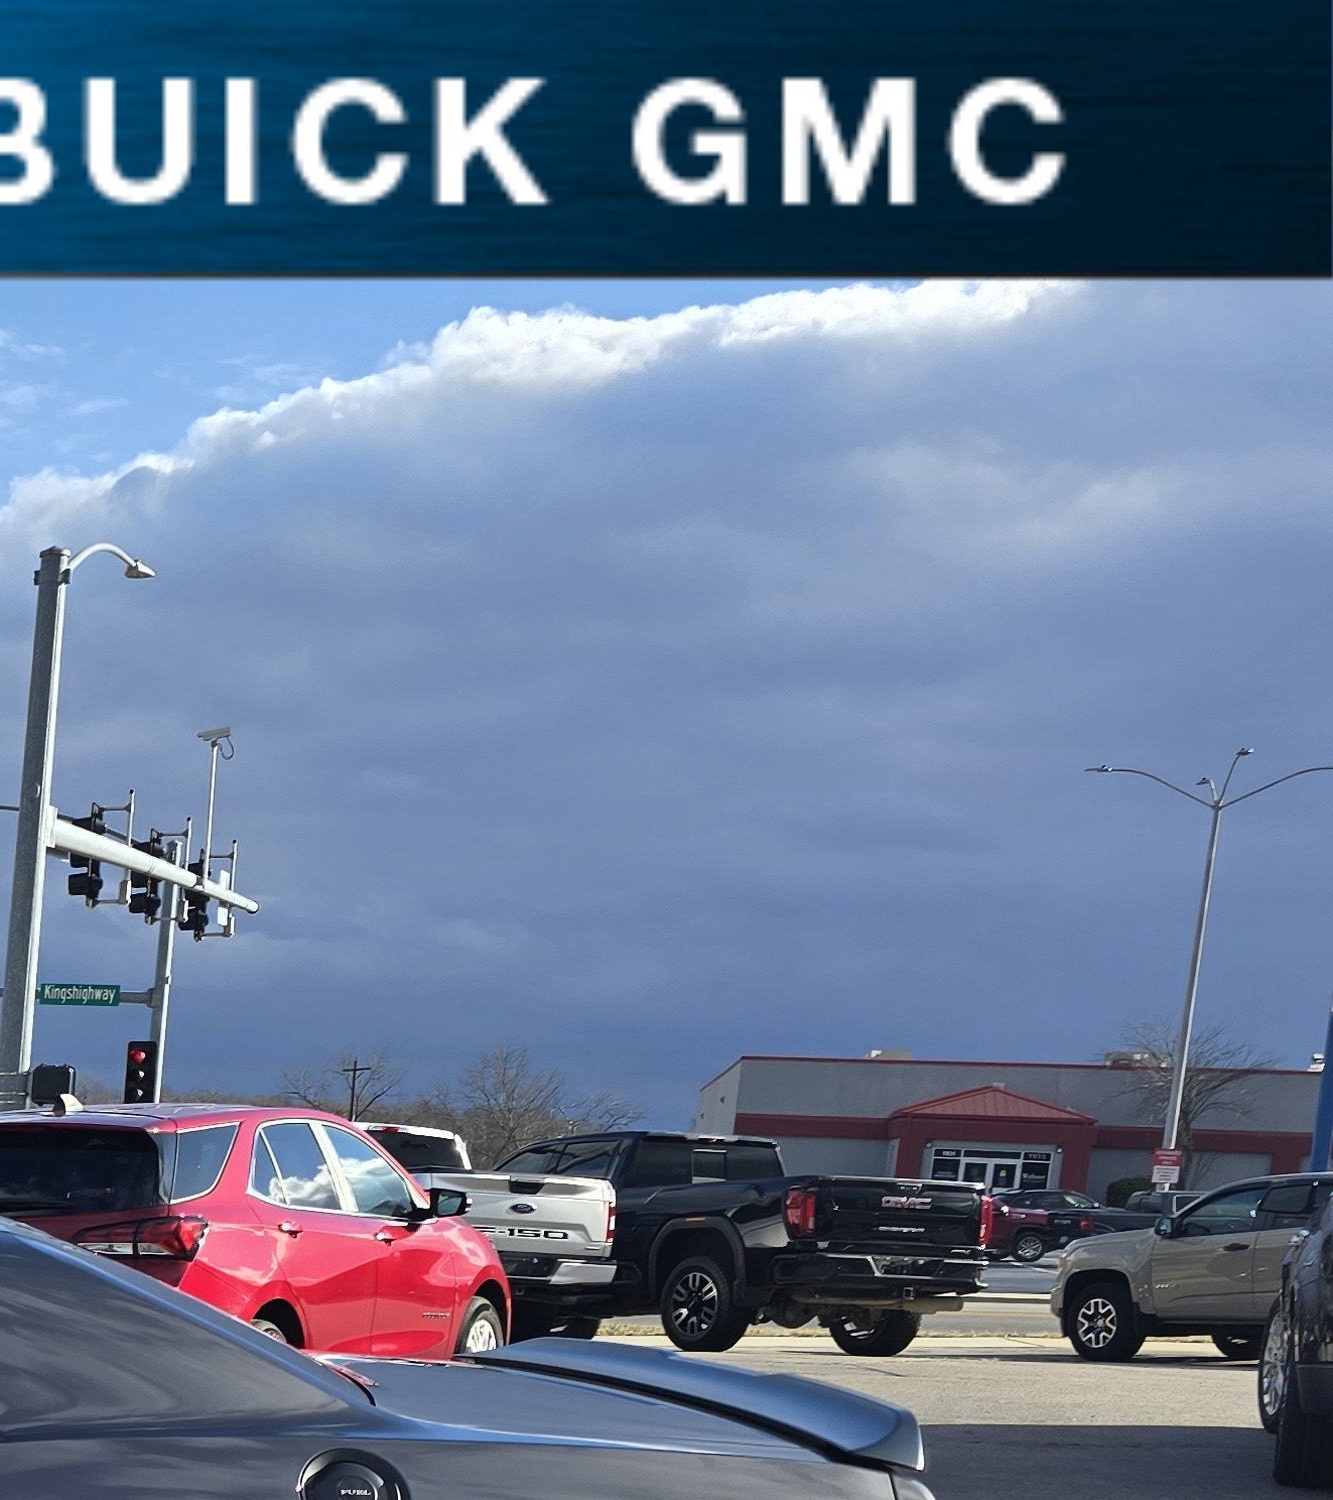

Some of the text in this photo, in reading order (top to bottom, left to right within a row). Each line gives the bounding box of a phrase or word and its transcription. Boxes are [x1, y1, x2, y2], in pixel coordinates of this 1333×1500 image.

[44, 985, 116, 1005] Kingshighway
[881, 1196, 933, 1210] GMC
[473, 1226, 569, 1240] F-150
[340, 1489, 372, 1497] FUEL
